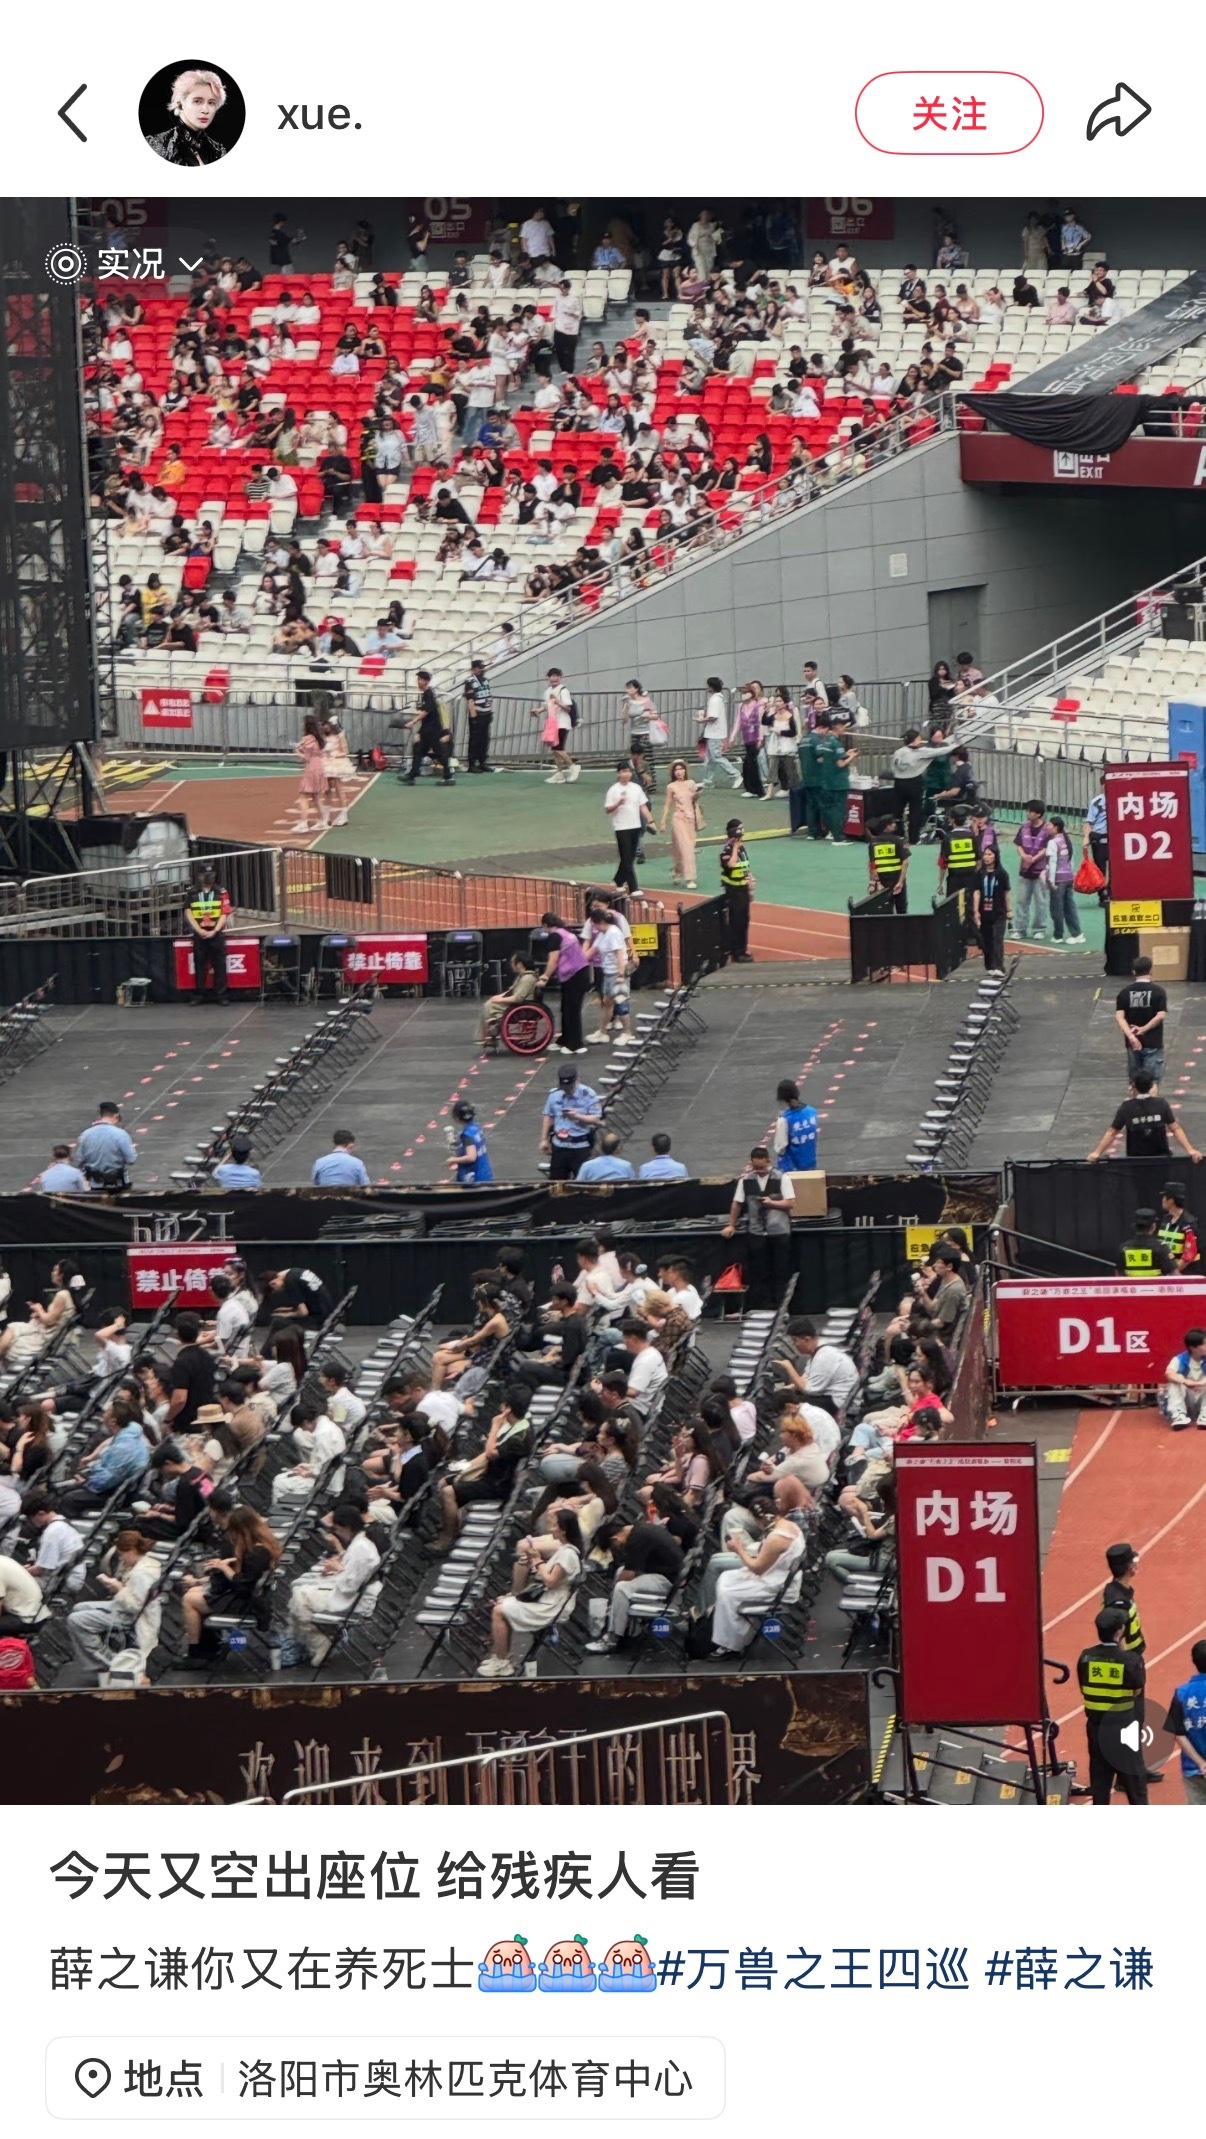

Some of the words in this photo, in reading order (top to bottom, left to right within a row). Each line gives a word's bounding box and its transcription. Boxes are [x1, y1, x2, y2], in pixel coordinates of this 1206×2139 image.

[1079, 466, 1104, 479] EXIT
[1117, 791, 1179, 822] 内场
[1123, 830, 1174, 861] D2
[347, 951, 424, 972] 禁止倚靠
[1058, 1316, 1151, 1354] D1区
[915, 1489, 1019, 1537] 内场
[925, 1556, 1007, 1603] D1
